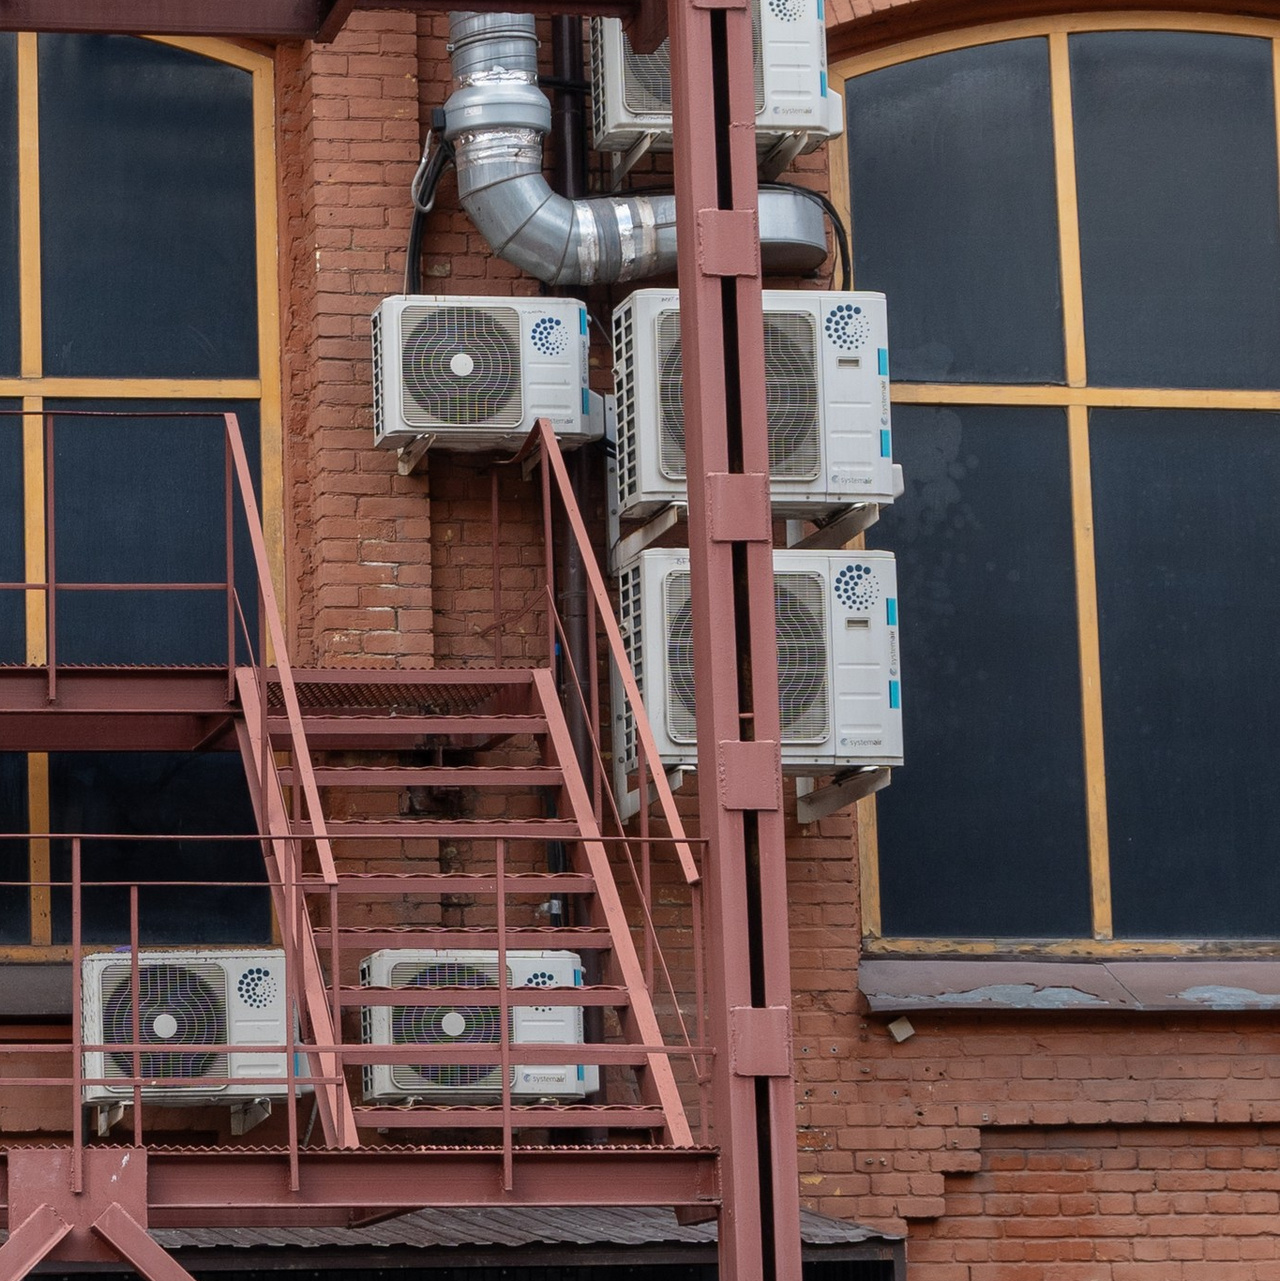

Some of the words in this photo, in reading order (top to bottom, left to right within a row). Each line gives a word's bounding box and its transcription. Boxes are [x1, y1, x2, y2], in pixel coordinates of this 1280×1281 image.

[880, 380, 888, 415] systemair
[840, 477, 873, 486] systemair
[849, 738, 882, 747] systemair
[533, 1075, 565, 1083] systemair
